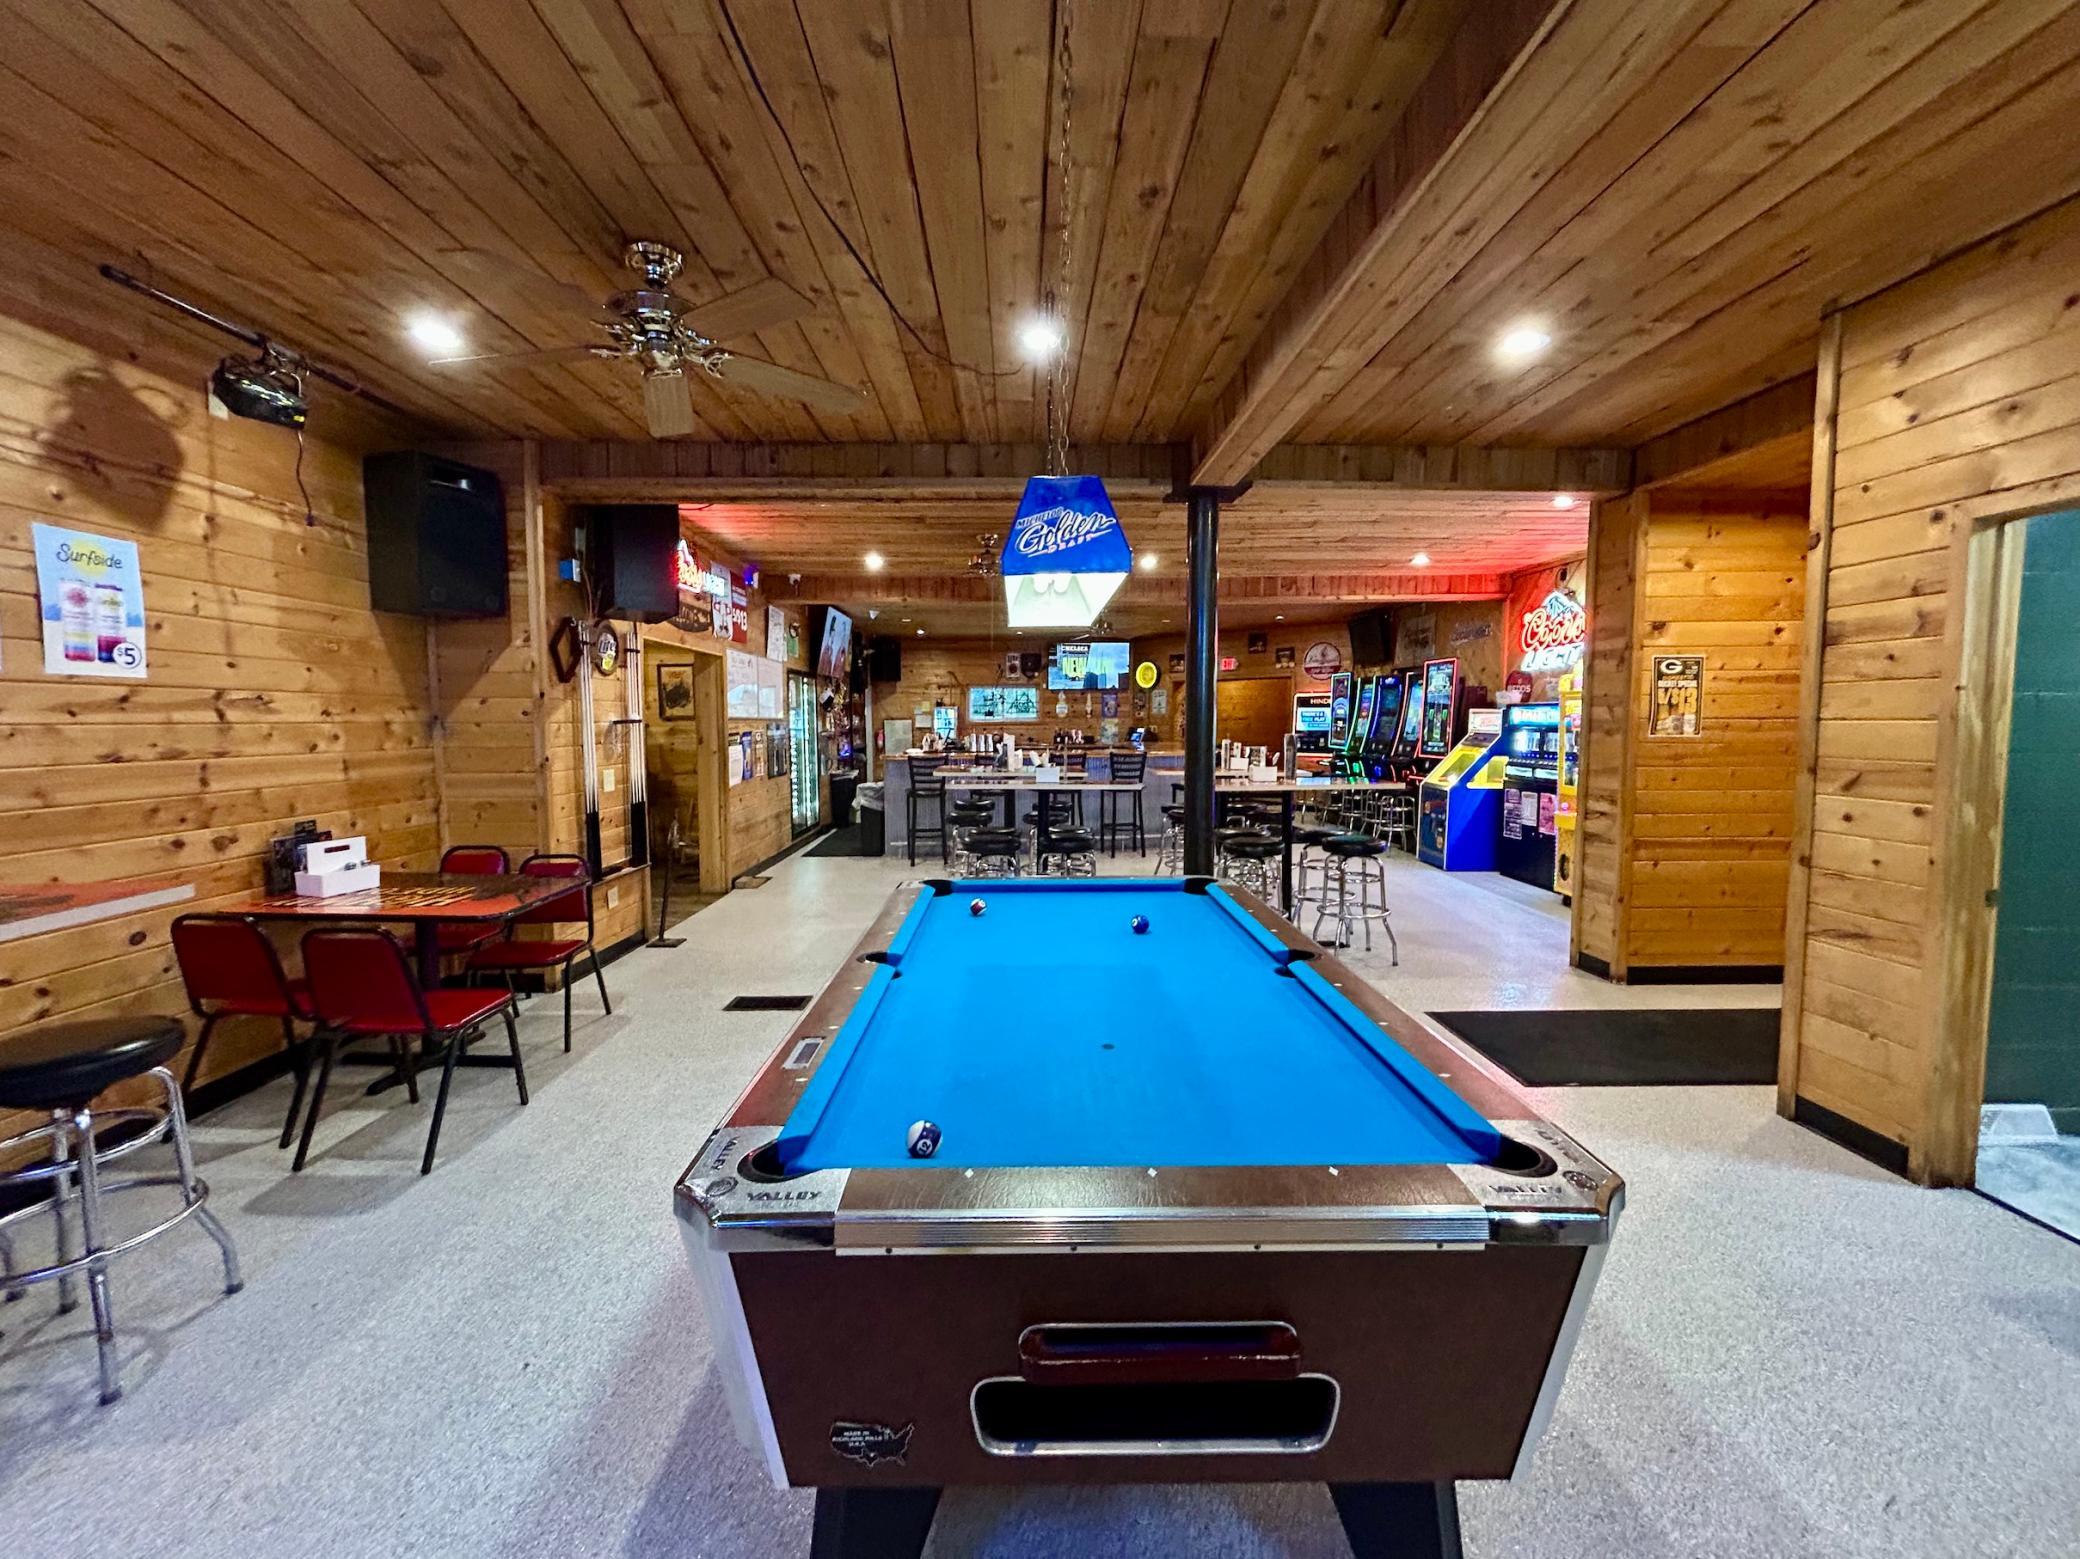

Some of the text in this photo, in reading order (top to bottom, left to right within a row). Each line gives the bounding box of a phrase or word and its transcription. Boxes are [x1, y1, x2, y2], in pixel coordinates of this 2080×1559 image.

[1015, 509, 1117, 554] Golden
[56, 543, 123, 569] Surfside
[747, 1190, 822, 1201] VALLEY
